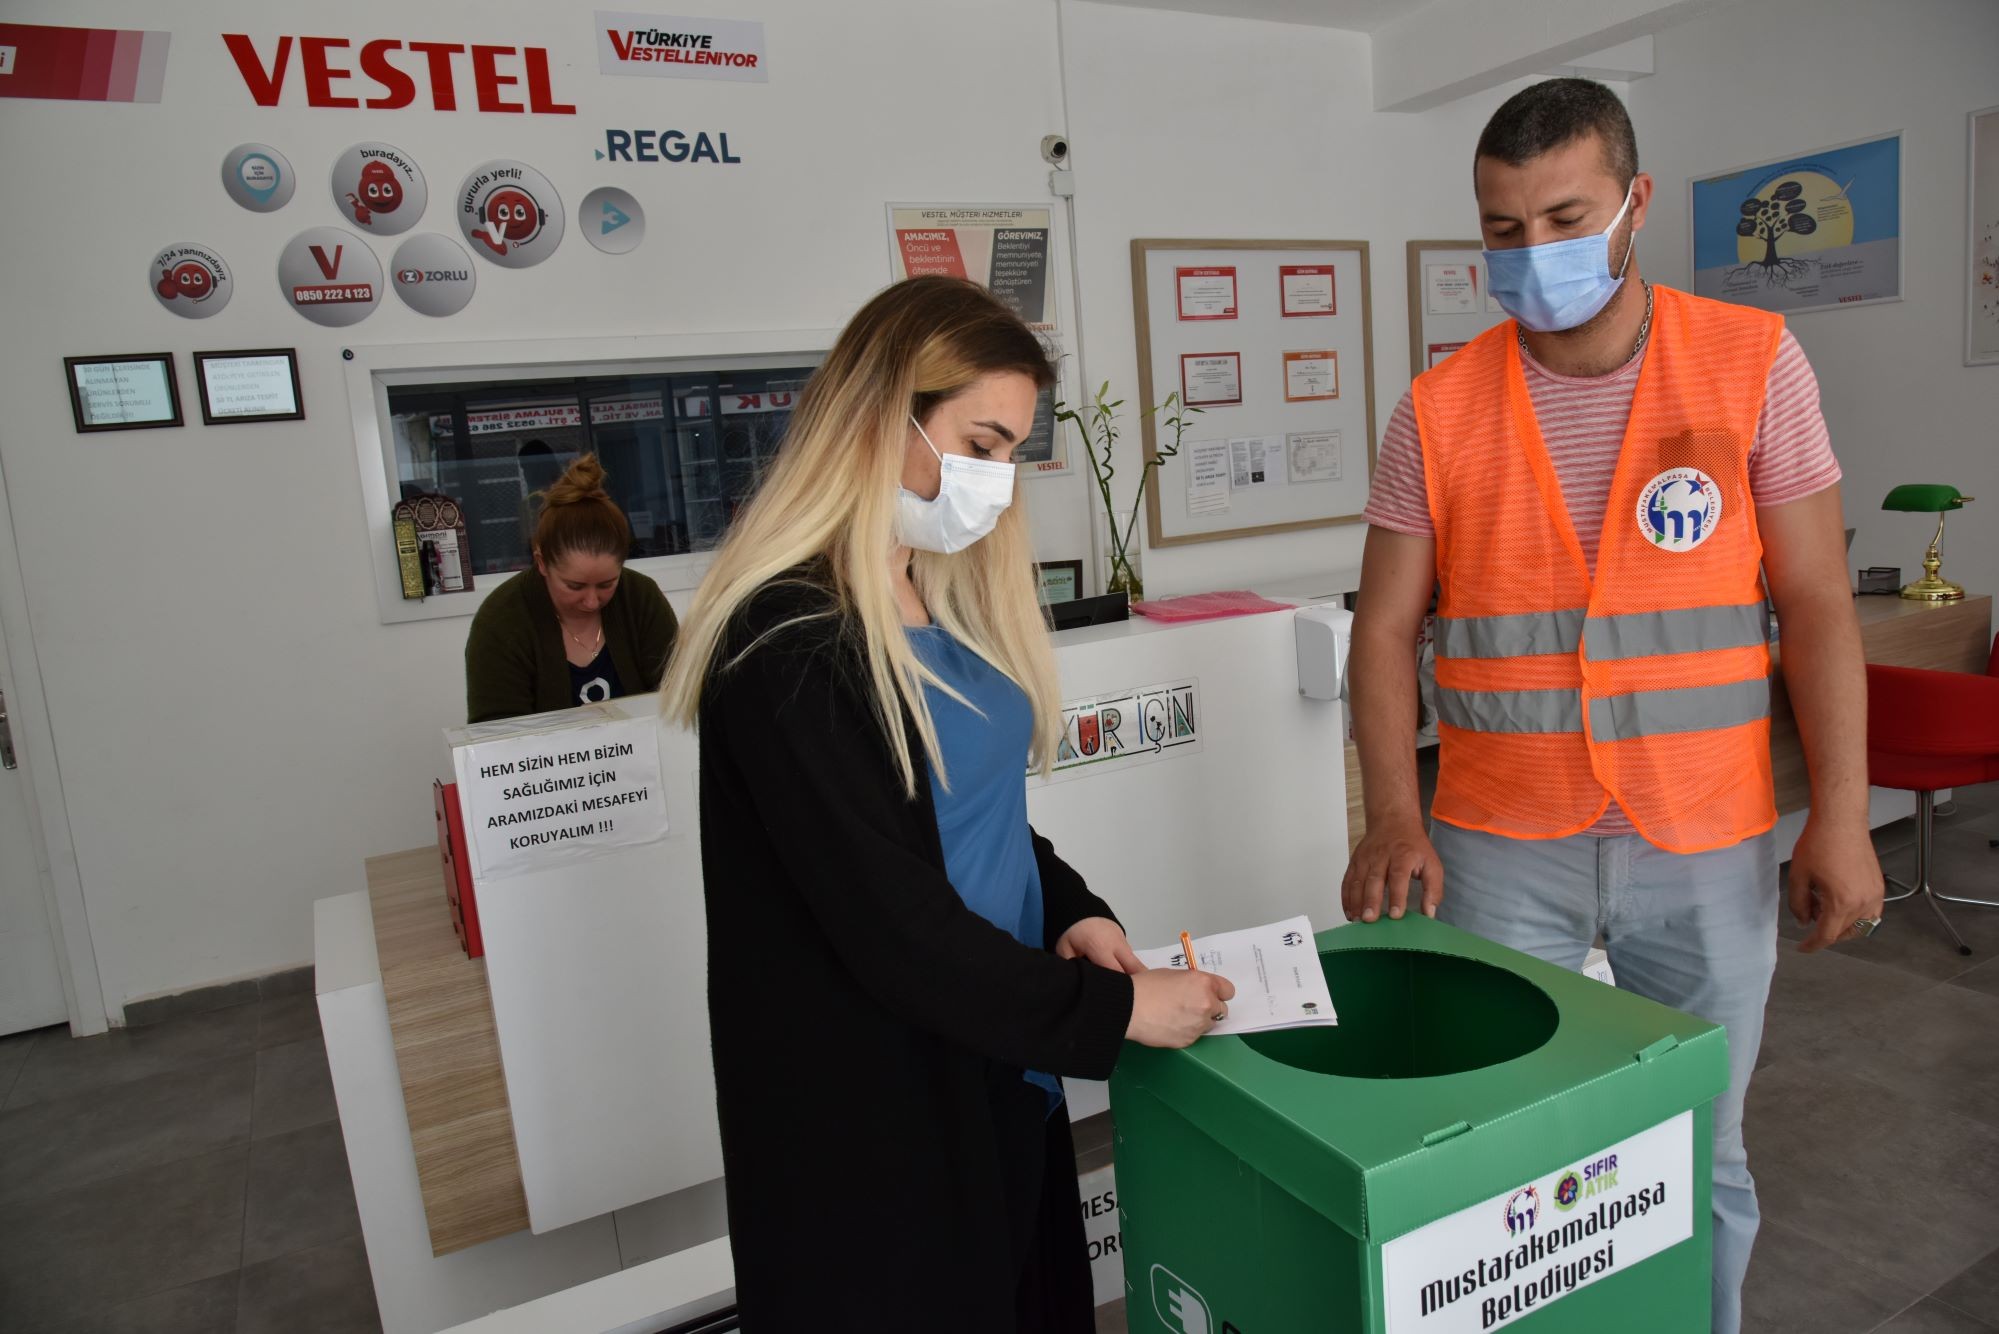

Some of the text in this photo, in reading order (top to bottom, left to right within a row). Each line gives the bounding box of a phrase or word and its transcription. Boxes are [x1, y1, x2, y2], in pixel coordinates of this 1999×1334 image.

[221, 33, 577, 115] VESTEL
[606, 129, 741, 164] REGAL
[464, 168, 522, 213] gururla yerli!
[904, 232, 950, 242] AMACIMIZ,
[906, 242, 929, 252] Öncü
[997, 242, 1031, 251] Beklentiyi
[157, 250, 176, 268] 7/24
[909, 255, 955, 264] beklentinin
[912, 266, 948, 275] ötesinde
[996, 261, 1039, 269] memnuniyeti
[425, 269, 468, 282] ZORLU
[296, 287, 323, 302] 0850
[325, 287, 344, 301] 222
[353, 286, 371, 300] 123
[1037, 462, 1065, 471] VESTEL
[480, 743, 634, 779] HEM SİZİN HEM BİZİM
[503, 770, 616, 801] SAĞLIĞIMIZ İÇİN
[487, 787, 648, 829] ARAMIZDAKİ MESAFEYİ
[510, 819, 614, 850] KORUYALIM !!!
[1583, 1153, 1618, 1182] SIFIR
[1584, 1169, 1619, 1199] ATIK
[1481, 1240, 1614, 1330] Belediyesi
